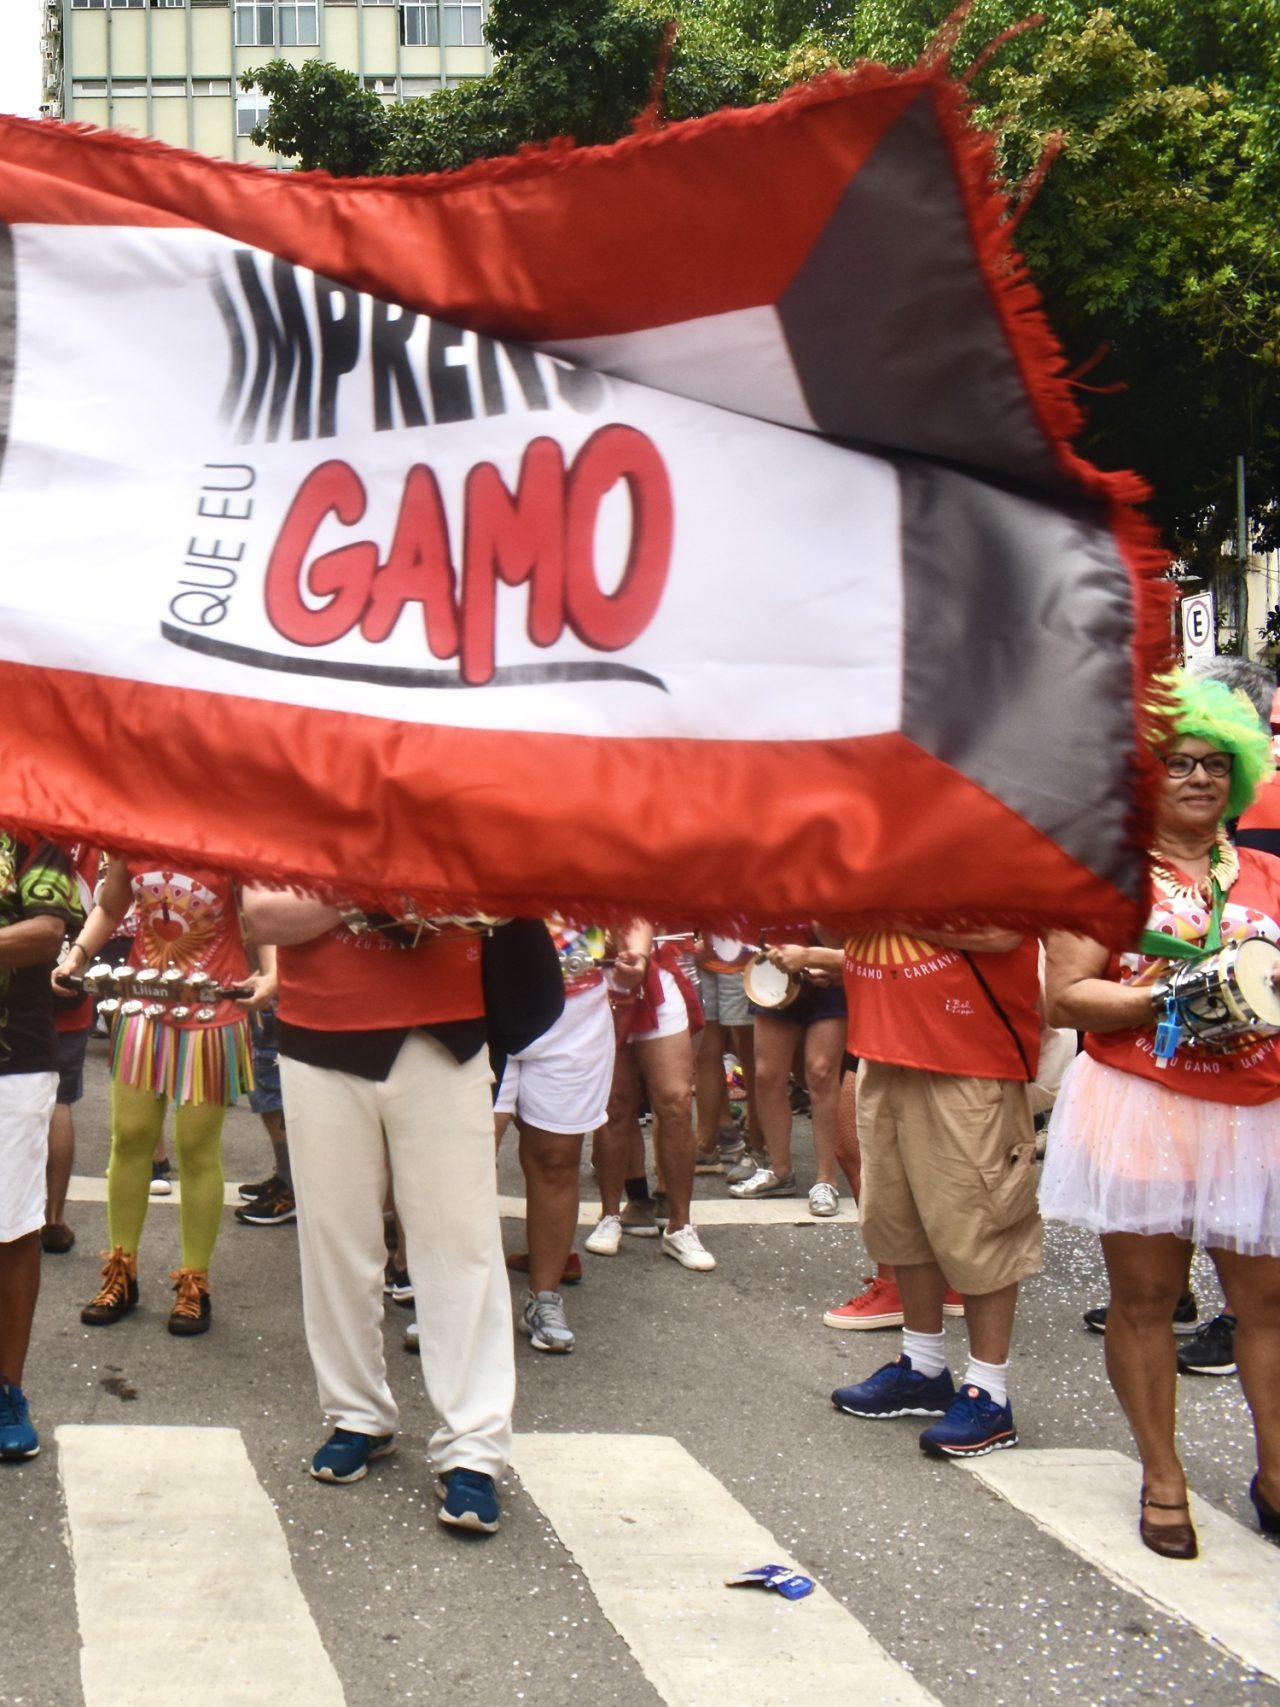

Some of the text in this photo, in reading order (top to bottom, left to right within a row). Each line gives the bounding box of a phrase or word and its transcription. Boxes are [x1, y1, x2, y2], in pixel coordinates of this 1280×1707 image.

[169, 463, 256, 627] QUE EU
[264, 423, 674, 685] GAMO
[1193, 610, 1202, 637] E
[856, 965, 882, 980] GAMO
[903, 951, 960, 979] CARNAVA
[132, 984, 169, 997] Lilian
[1184, 1060, 1220, 1073] GAMO
